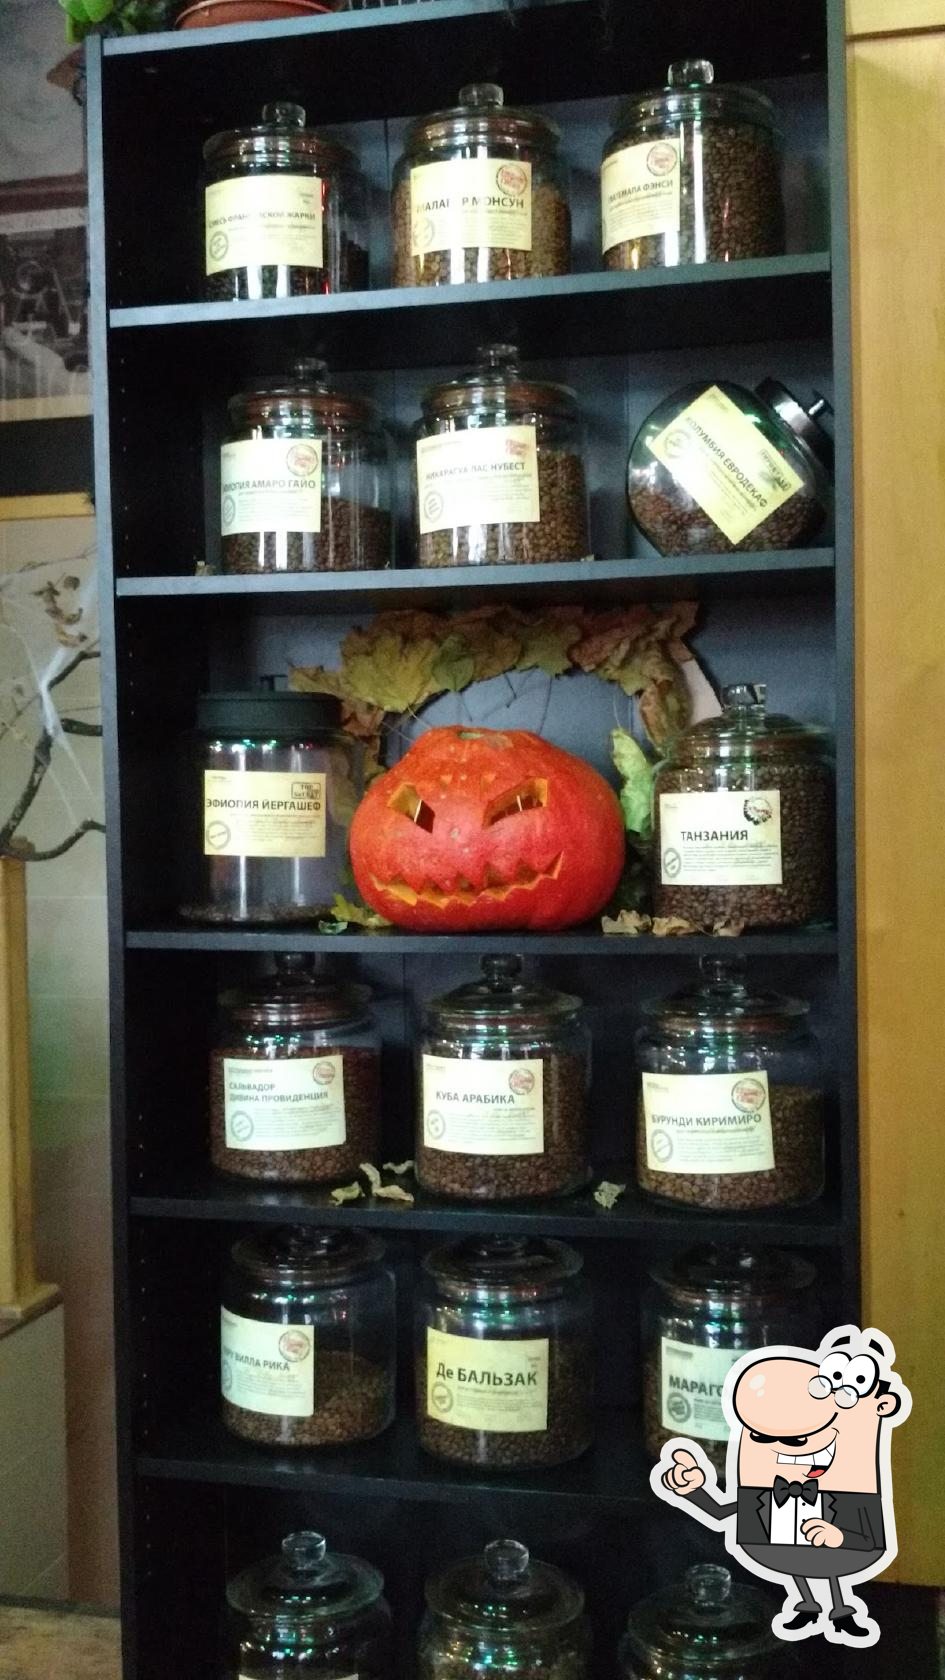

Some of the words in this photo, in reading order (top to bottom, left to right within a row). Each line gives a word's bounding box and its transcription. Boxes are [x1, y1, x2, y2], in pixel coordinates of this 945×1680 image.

[643, 179, 674, 192] ФЭНСИ
[685, 416, 726, 460] КОЛУМБИЯ
[722, 457, 768, 508] ЕВРОДЕКАФ
[251, 480, 286, 489] АМАРО
[205, 799, 259, 809] ЭФИОПИЯ
[262, 798, 321, 811] ЙЕРГАШЕФ
[680, 829, 749, 842] ТАНЗАНИЯ
[228, 1081, 276, 1092] САЛЬВАДОР
[261, 1091, 329, 1103] ПРОВИДЕНЦИЯ
[435, 1090, 460, 1102] КУБА
[462, 1093, 515, 1105] АРАБИКА
[651, 1114, 693, 1127] БУРУНДИ
[695, 1113, 762, 1126] КИРИМИРО
[263, 1360, 290, 1372] РИКА
[436, 1362, 454, 1381] Де
[457, 1368, 537, 1387] БАЛЬЗАК
